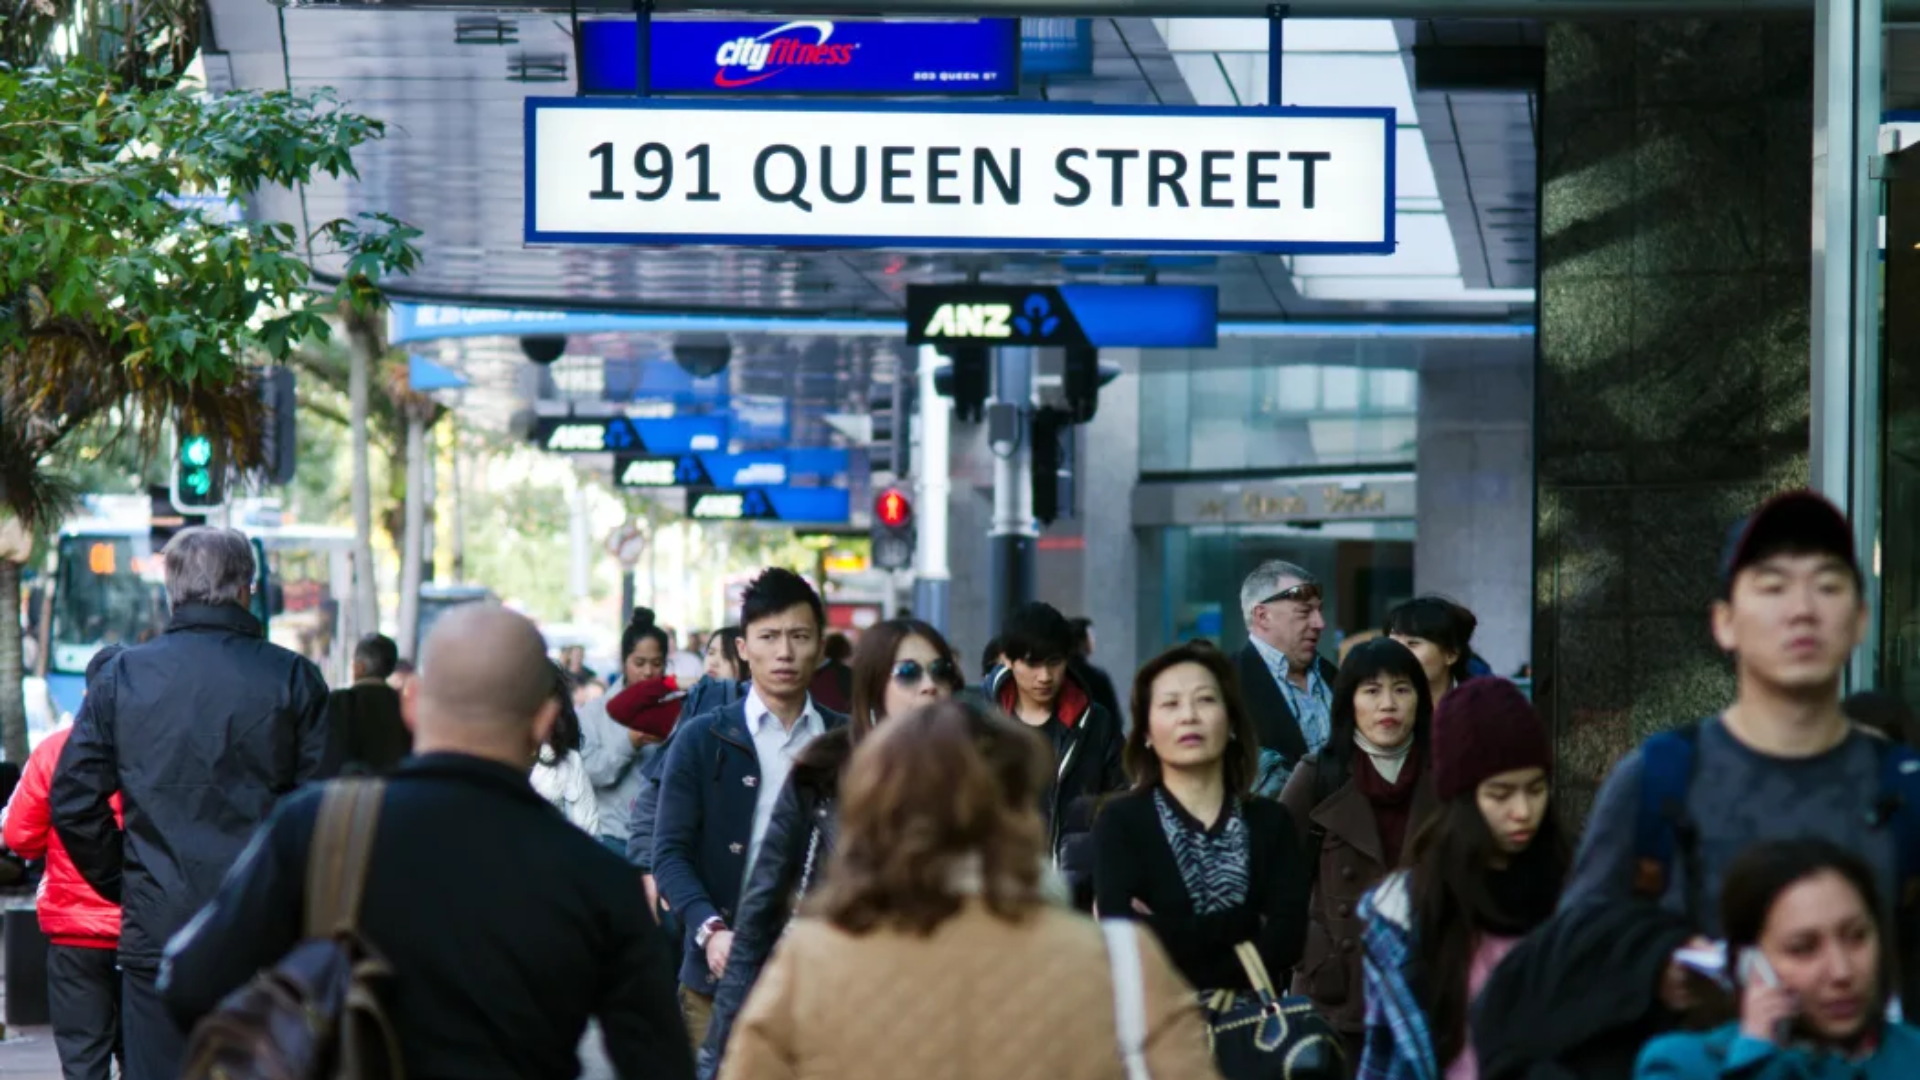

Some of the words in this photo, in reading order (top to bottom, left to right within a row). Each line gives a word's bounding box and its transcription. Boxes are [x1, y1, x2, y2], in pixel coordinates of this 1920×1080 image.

[939, 71, 979, 82] QUEEN
[588, 141, 721, 202] 191
[752, 143, 1022, 213] QUEEN
[1053, 147, 1332, 209] STREET
[924, 303, 1012, 337] ANZ
